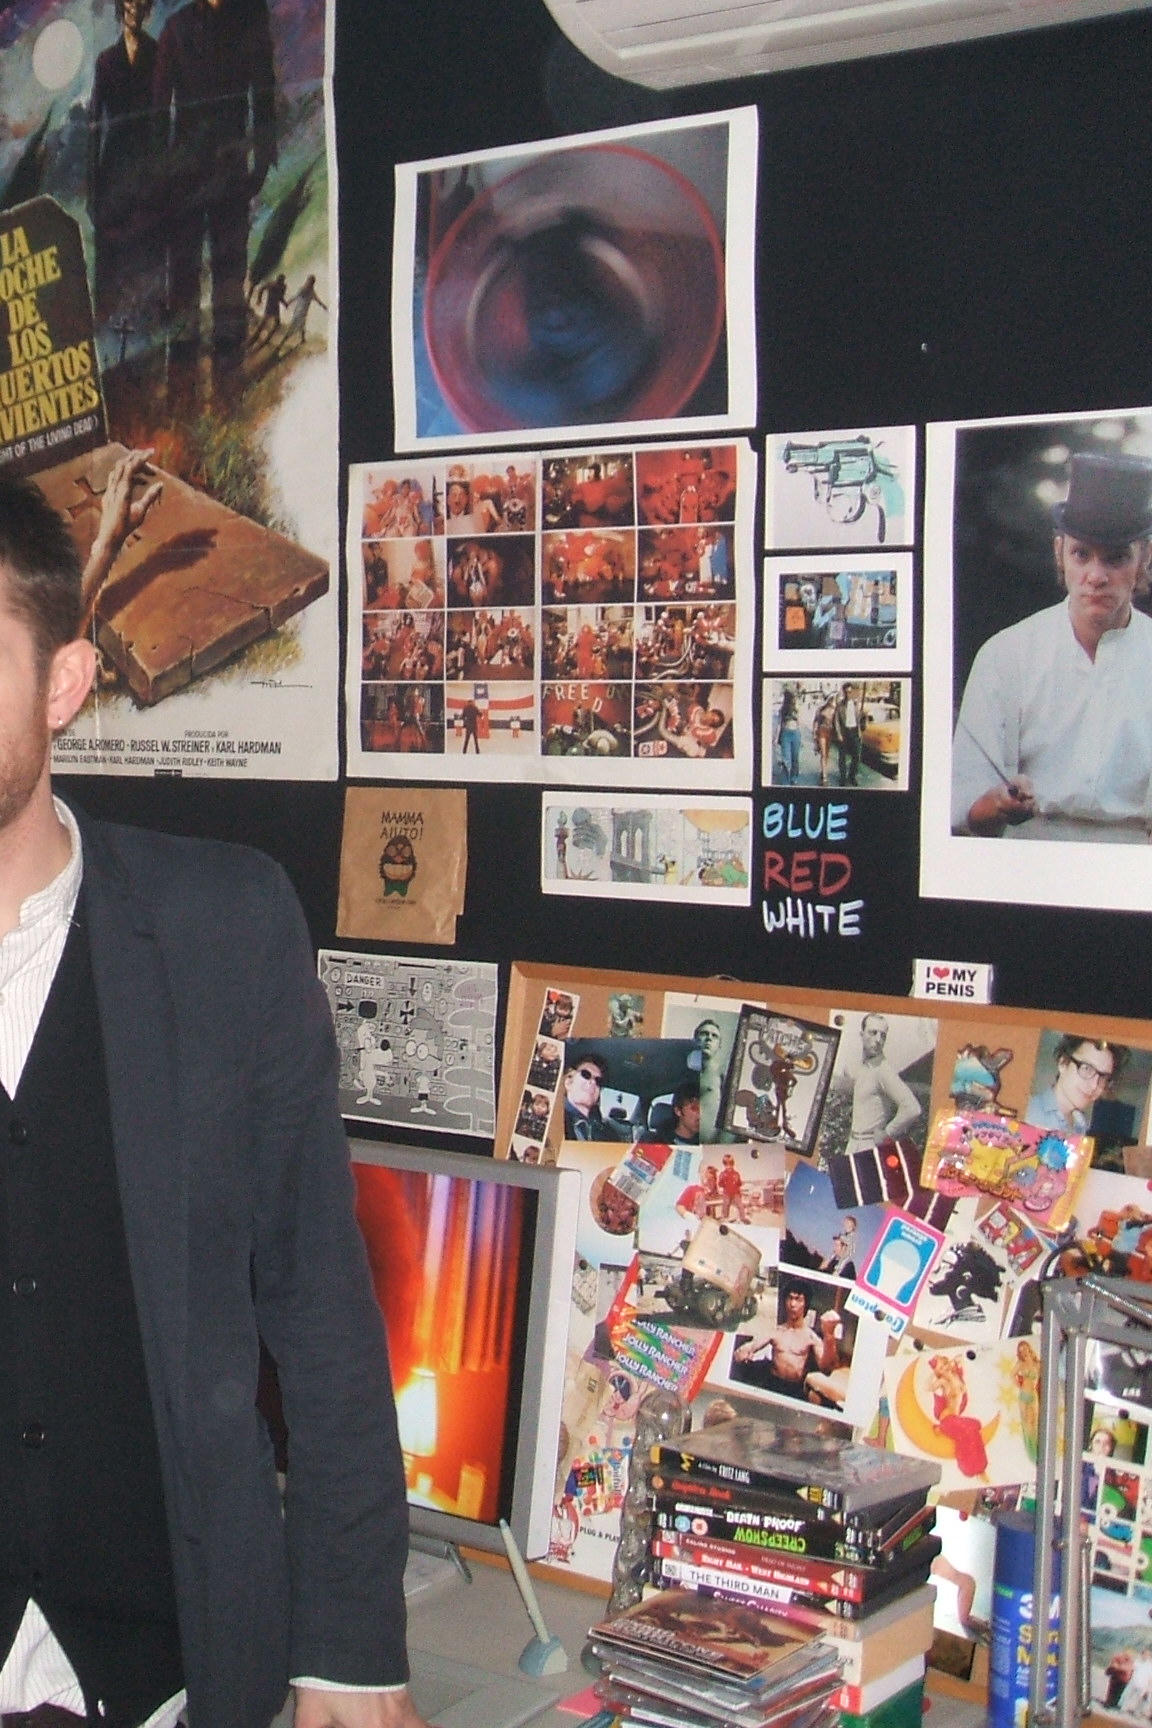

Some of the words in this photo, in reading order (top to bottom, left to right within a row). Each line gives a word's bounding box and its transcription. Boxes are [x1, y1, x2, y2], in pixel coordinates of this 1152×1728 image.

[0, 226, 30, 265] LA
[7, 292, 41, 331] DE
[8, 320, 52, 367] LOS
[57, 738, 87, 751] GEORGE
[130, 739, 160, 752] RUSSEL
[215, 740, 236, 754] KARL
[237, 741, 282, 755] HARDMAN
[206, 757, 225, 767] KEITH
[381, 810, 424, 825] MAMMA
[763, 802, 849, 841] BLUE
[764, 850, 852, 896] RED
[762, 896, 865, 939] WHITE
[346, 972, 382, 987] DANGER
[925, 966, 930, 979] I
[952, 969, 978, 983] MY
[925, 981, 975, 998] PENIS
[851, 1294, 905, 1333] Cropton
[623, 1333, 648, 1352] JOLLY
[648, 1345, 688, 1375] RANCHER
[655, 1328, 696, 1357] RANCHER
[639, 1364, 678, 1392] RANCHER
[718, 1464, 735, 1480] FRITZ
[734, 1468, 750, 1484] LANG
[579, 1526, 596, 1537] PLUG
[733, 1526, 806, 1554] CREEPSHOW
[689, 1569, 712, 1584] THE
[714, 1575, 751, 1592] THIRD
[752, 1583, 781, 1600] MAN
[750, 1565, 771, 1578] WEST
